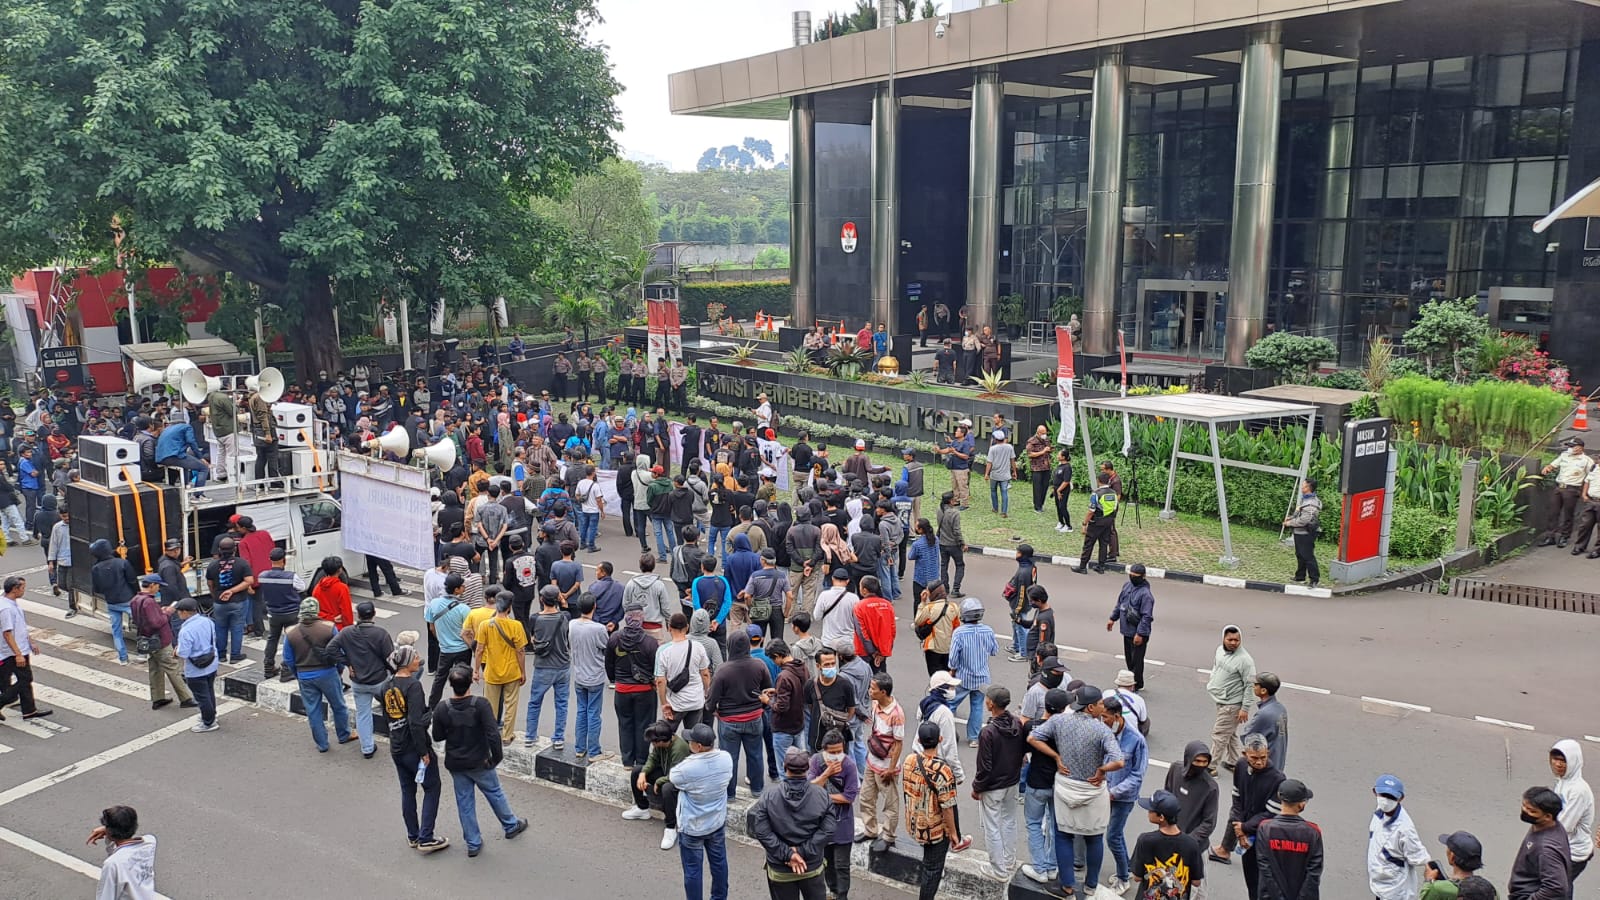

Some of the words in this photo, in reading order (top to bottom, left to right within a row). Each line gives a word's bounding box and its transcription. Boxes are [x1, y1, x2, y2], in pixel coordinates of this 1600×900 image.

[753, 380, 910, 426] PEMBERANTASAN
[1356, 429, 1375, 441] MASUK
[1269, 840, 1280, 850] AC
[1281, 840, 1308, 852] MILAN
